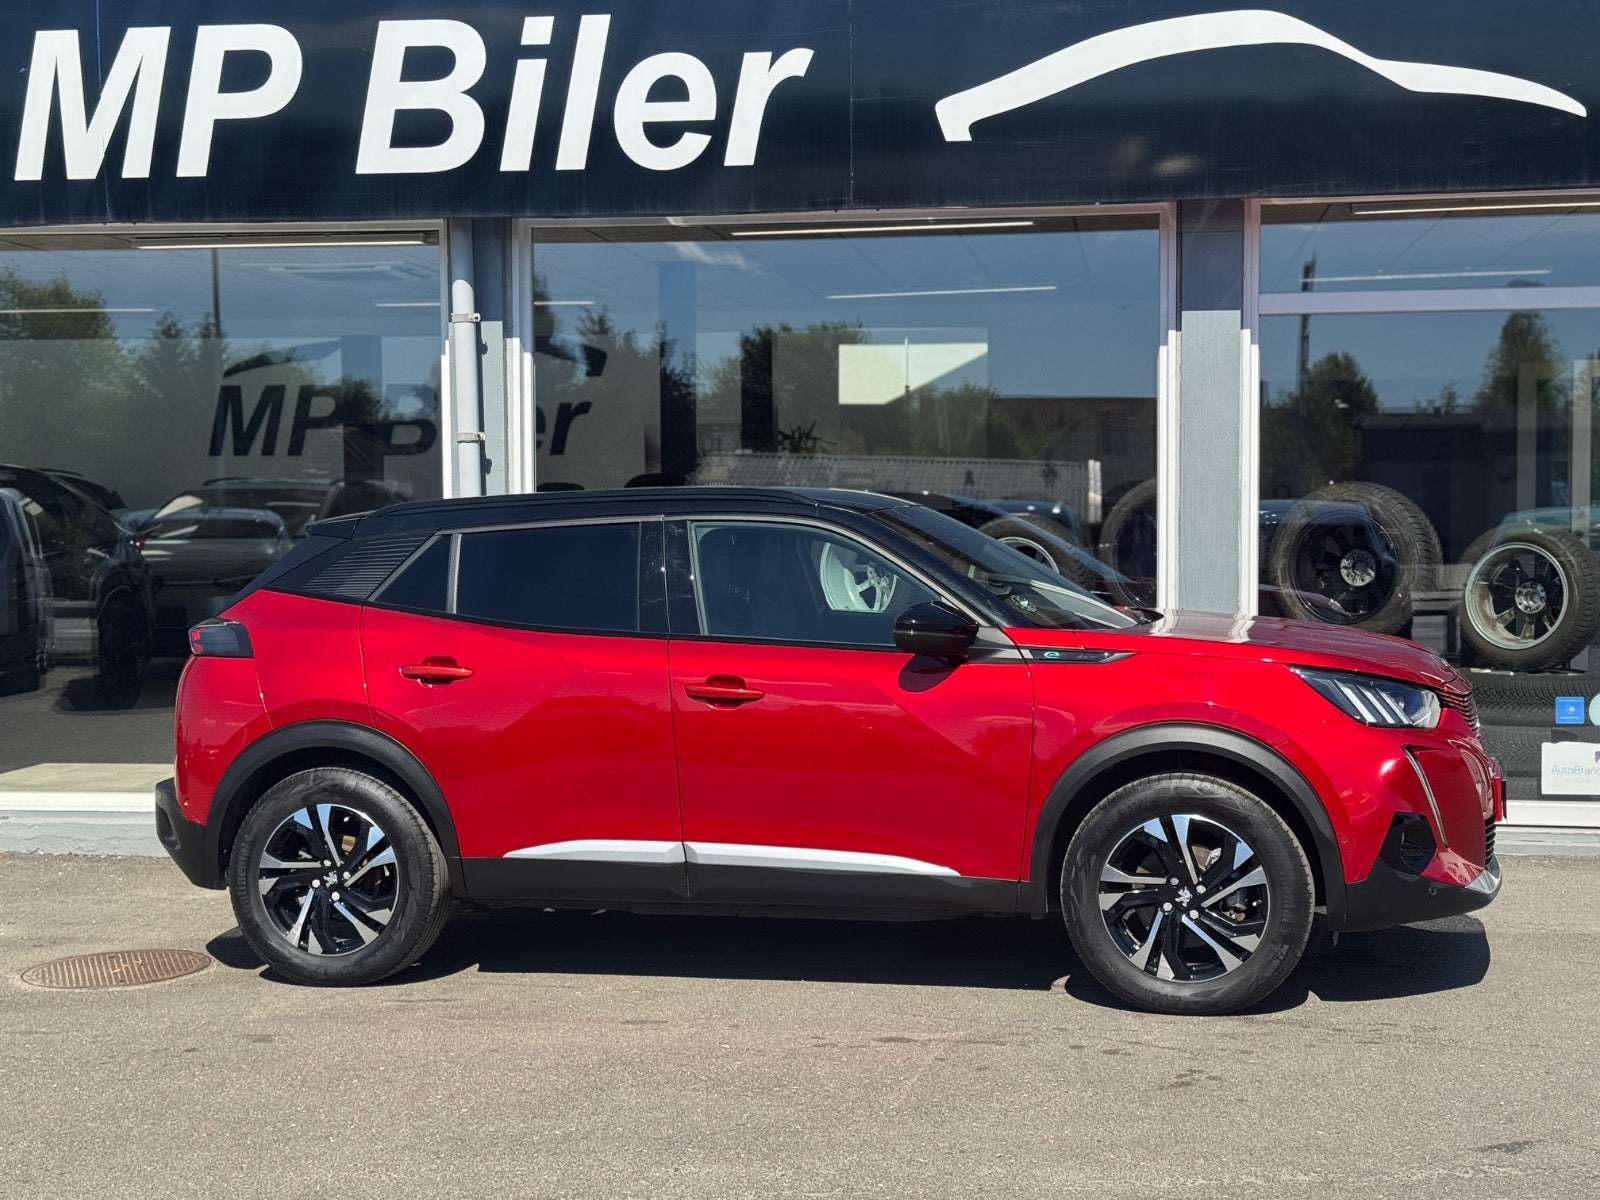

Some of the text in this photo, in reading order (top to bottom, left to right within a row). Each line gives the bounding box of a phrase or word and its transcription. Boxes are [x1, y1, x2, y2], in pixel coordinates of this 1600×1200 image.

[14, 13, 815, 181] MP Biler
[207, 384, 346, 457] MP
